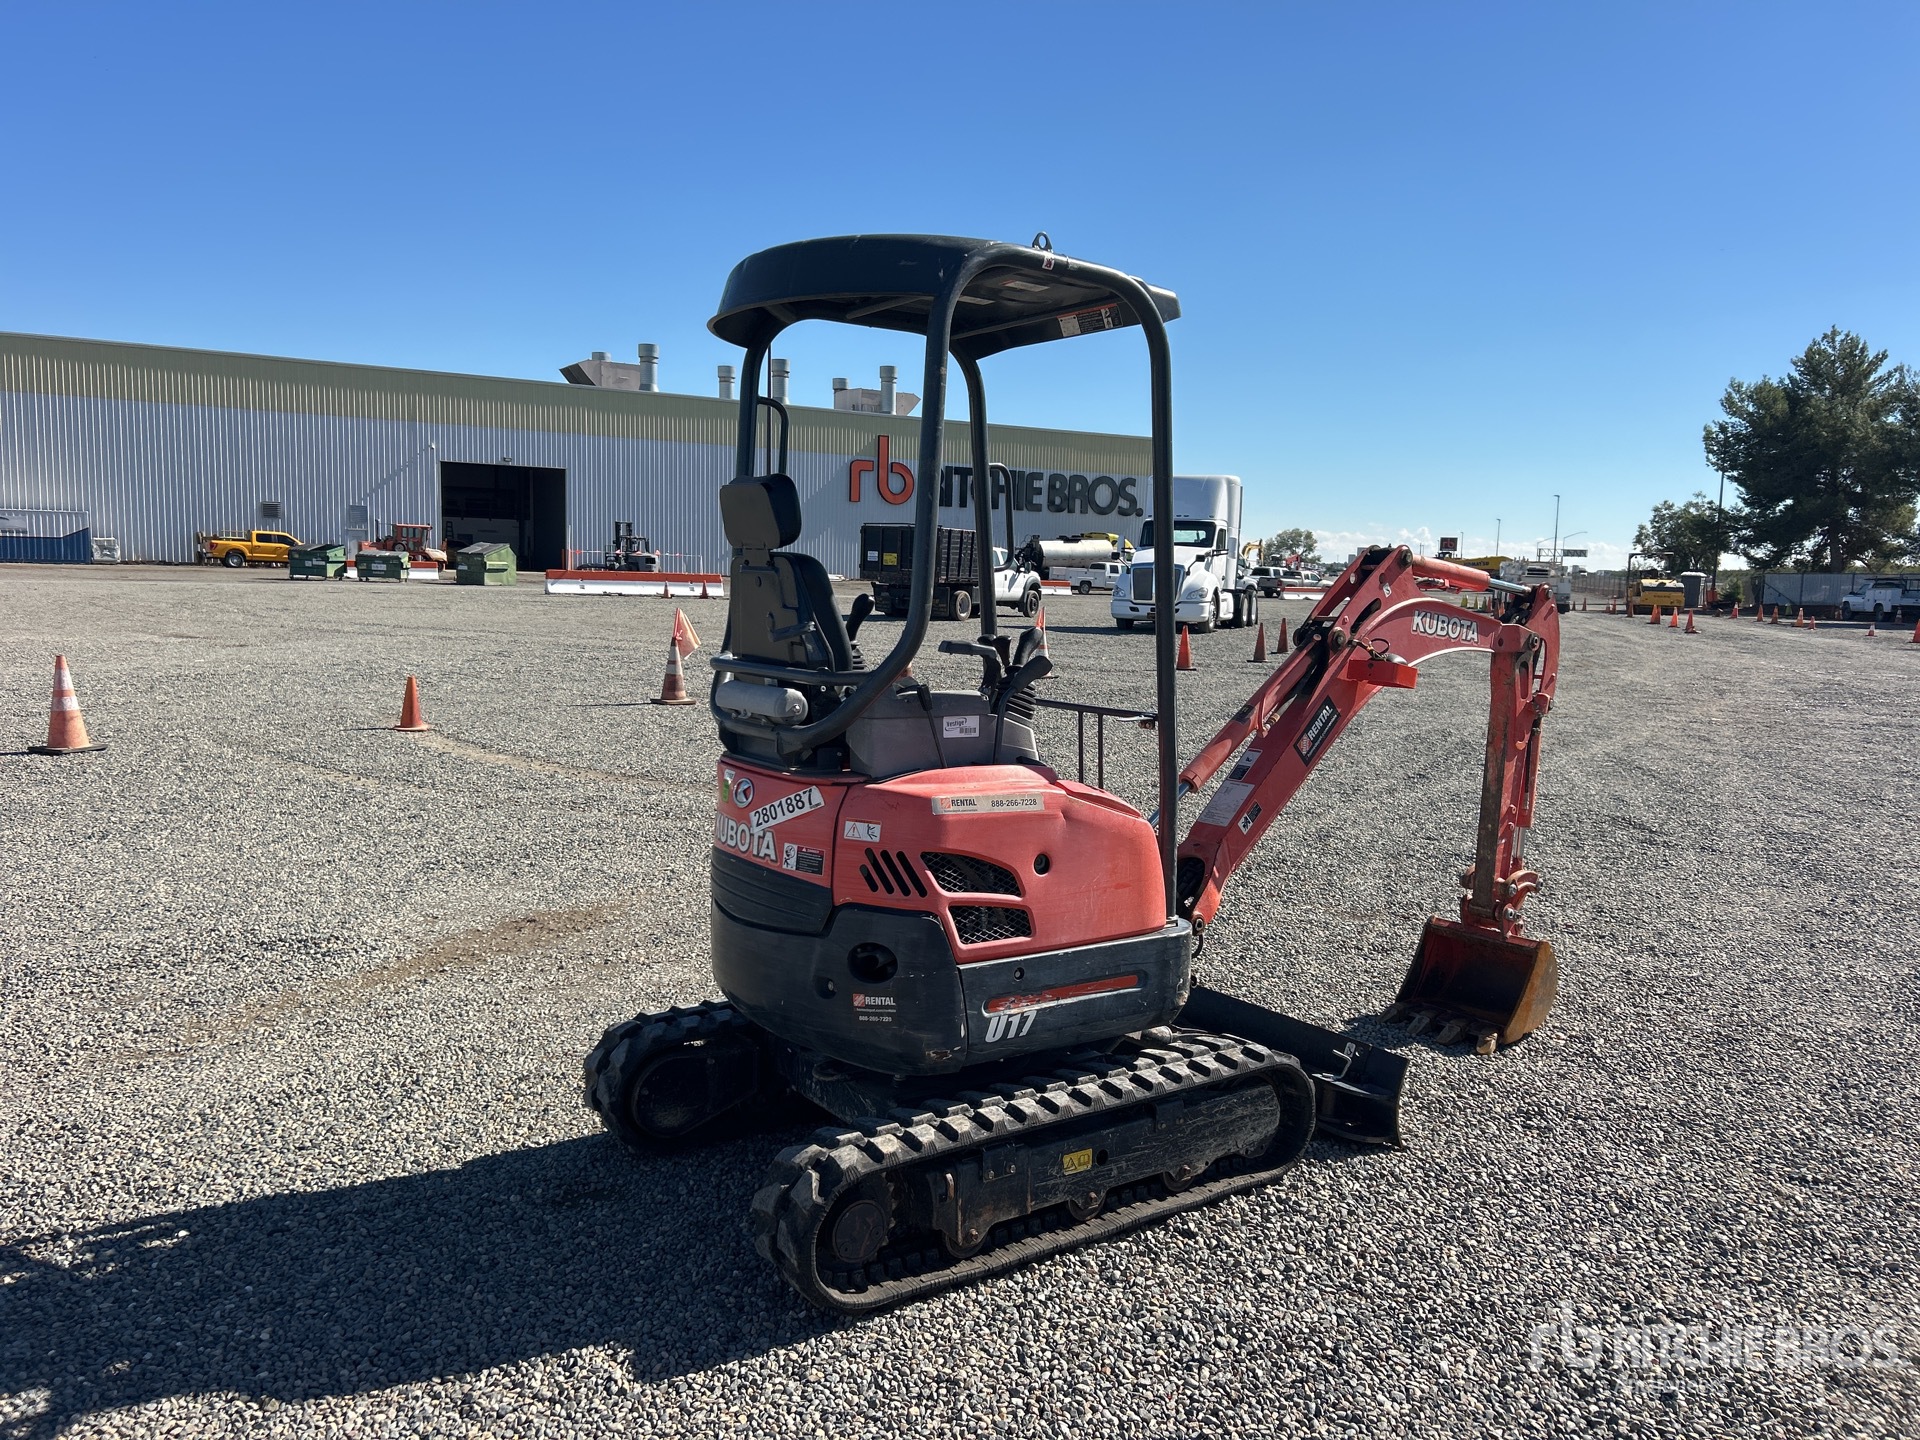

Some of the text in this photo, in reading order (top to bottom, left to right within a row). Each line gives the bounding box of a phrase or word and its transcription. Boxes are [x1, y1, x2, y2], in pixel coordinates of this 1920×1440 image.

[849, 435, 915, 506] rb
[1047, 473, 1144, 517] BROS.
[1412, 610, 1479, 642] KUBOTA
[1307, 705, 1333, 741] RENTAL
[754, 788, 813, 828] 2801887
[951, 798, 1038, 808] RENTAL 888-266-7228
[865, 996, 897, 1006] RENTAL
[985, 1009, 1037, 1043] U17
